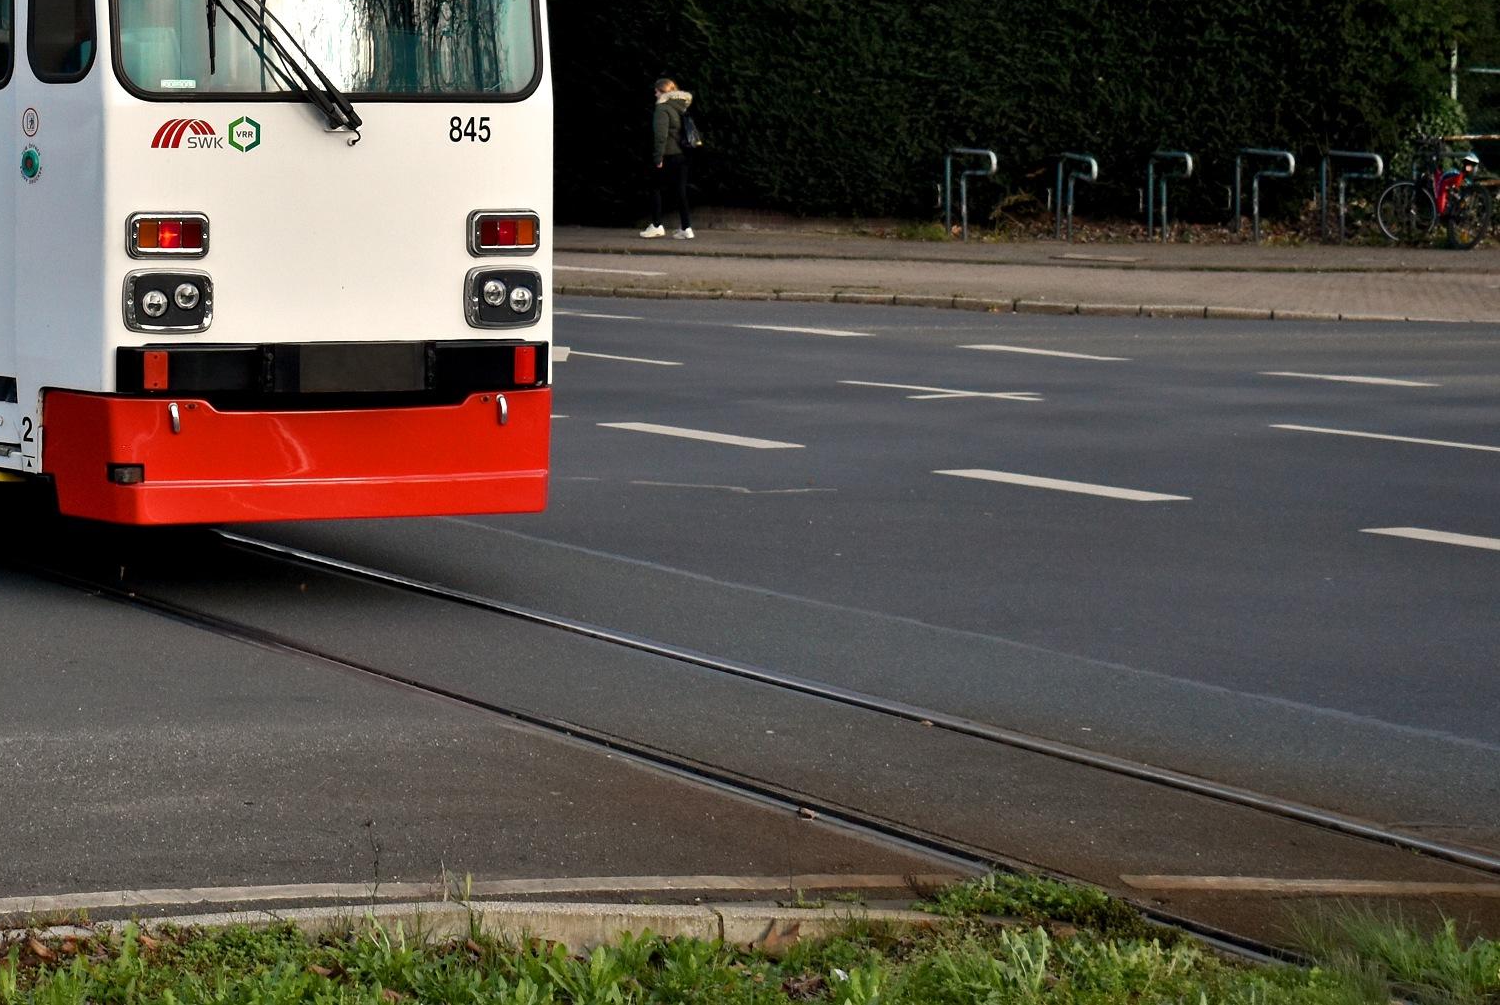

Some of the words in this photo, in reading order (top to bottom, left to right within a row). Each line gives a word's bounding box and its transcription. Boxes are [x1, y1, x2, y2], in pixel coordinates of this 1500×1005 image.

[235, 130, 254, 139] VRR
[449, 116, 491, 143] 845
[187, 136, 224, 149] SWK
[22, 416, 34, 442] 2
